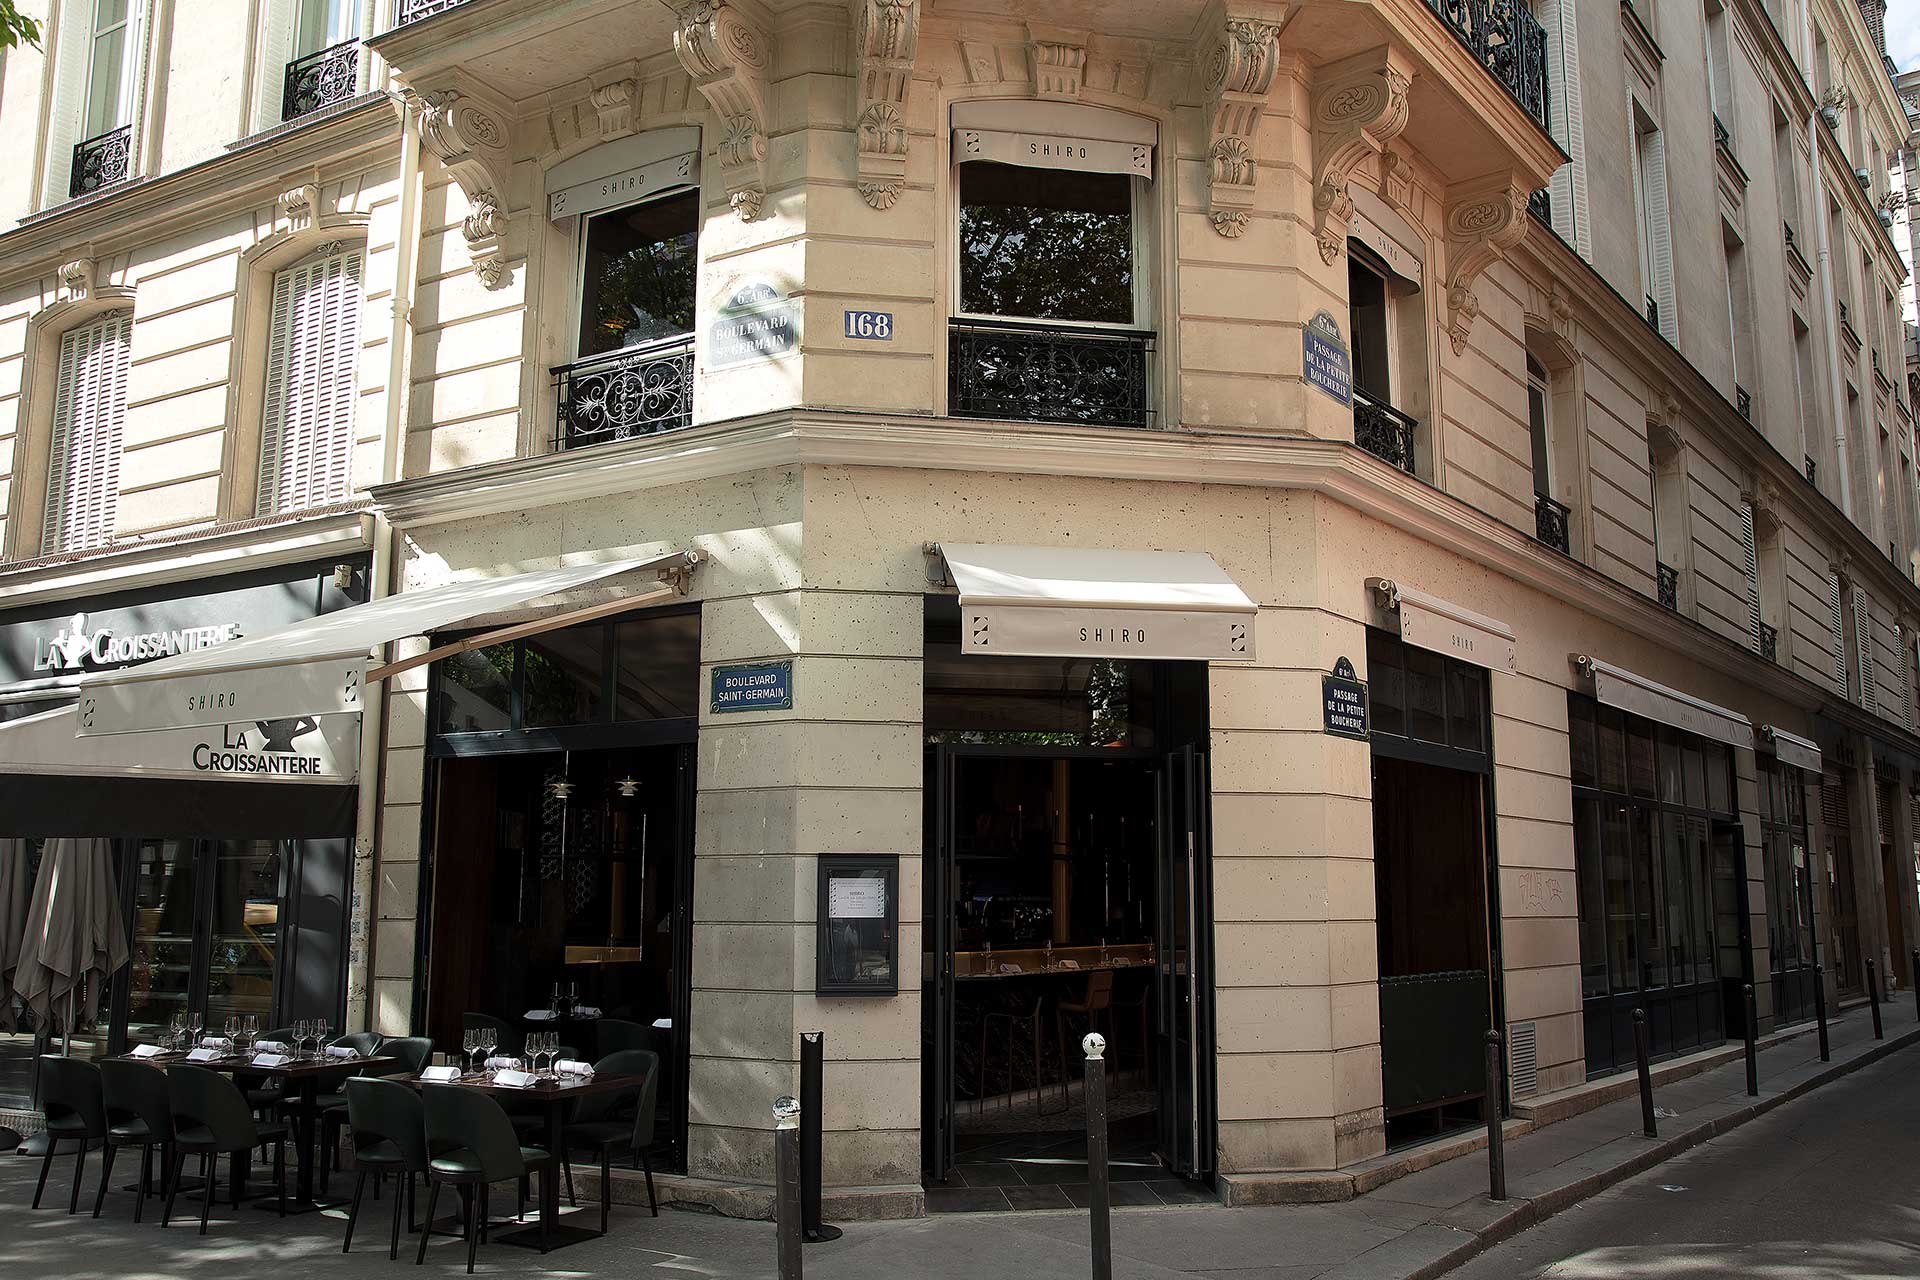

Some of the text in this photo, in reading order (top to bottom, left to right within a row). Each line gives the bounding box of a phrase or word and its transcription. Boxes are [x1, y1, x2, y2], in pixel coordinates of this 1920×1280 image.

[1030, 143, 1087, 158] SHIRO
[602, 174, 646, 196] SHIRO
[716, 315, 788, 340] BOULEVARD
[848, 312, 890, 337] 168
[732, 334, 785, 355] GERMAIN
[1313, 340, 1343, 366] PASSAGE
[1306, 350, 1350, 385] DE LA PETITE
[1310, 368, 1347, 398] BOUCHERIE
[1079, 628, 1146, 643] SHIRO
[726, 674, 777, 687] BOULEVARD
[188, 692, 236, 711] SHIRO
[718, 687, 784, 702] SAINT-GERMAIN
[1333, 689, 1358, 703] PASSAGE
[1327, 700, 1365, 717] DE LA PETITE
[1331, 714, 1362, 728] BOUCHERIE
[223, 724, 249, 750] LA
[192, 743, 321, 774] CROISSANTERIE
